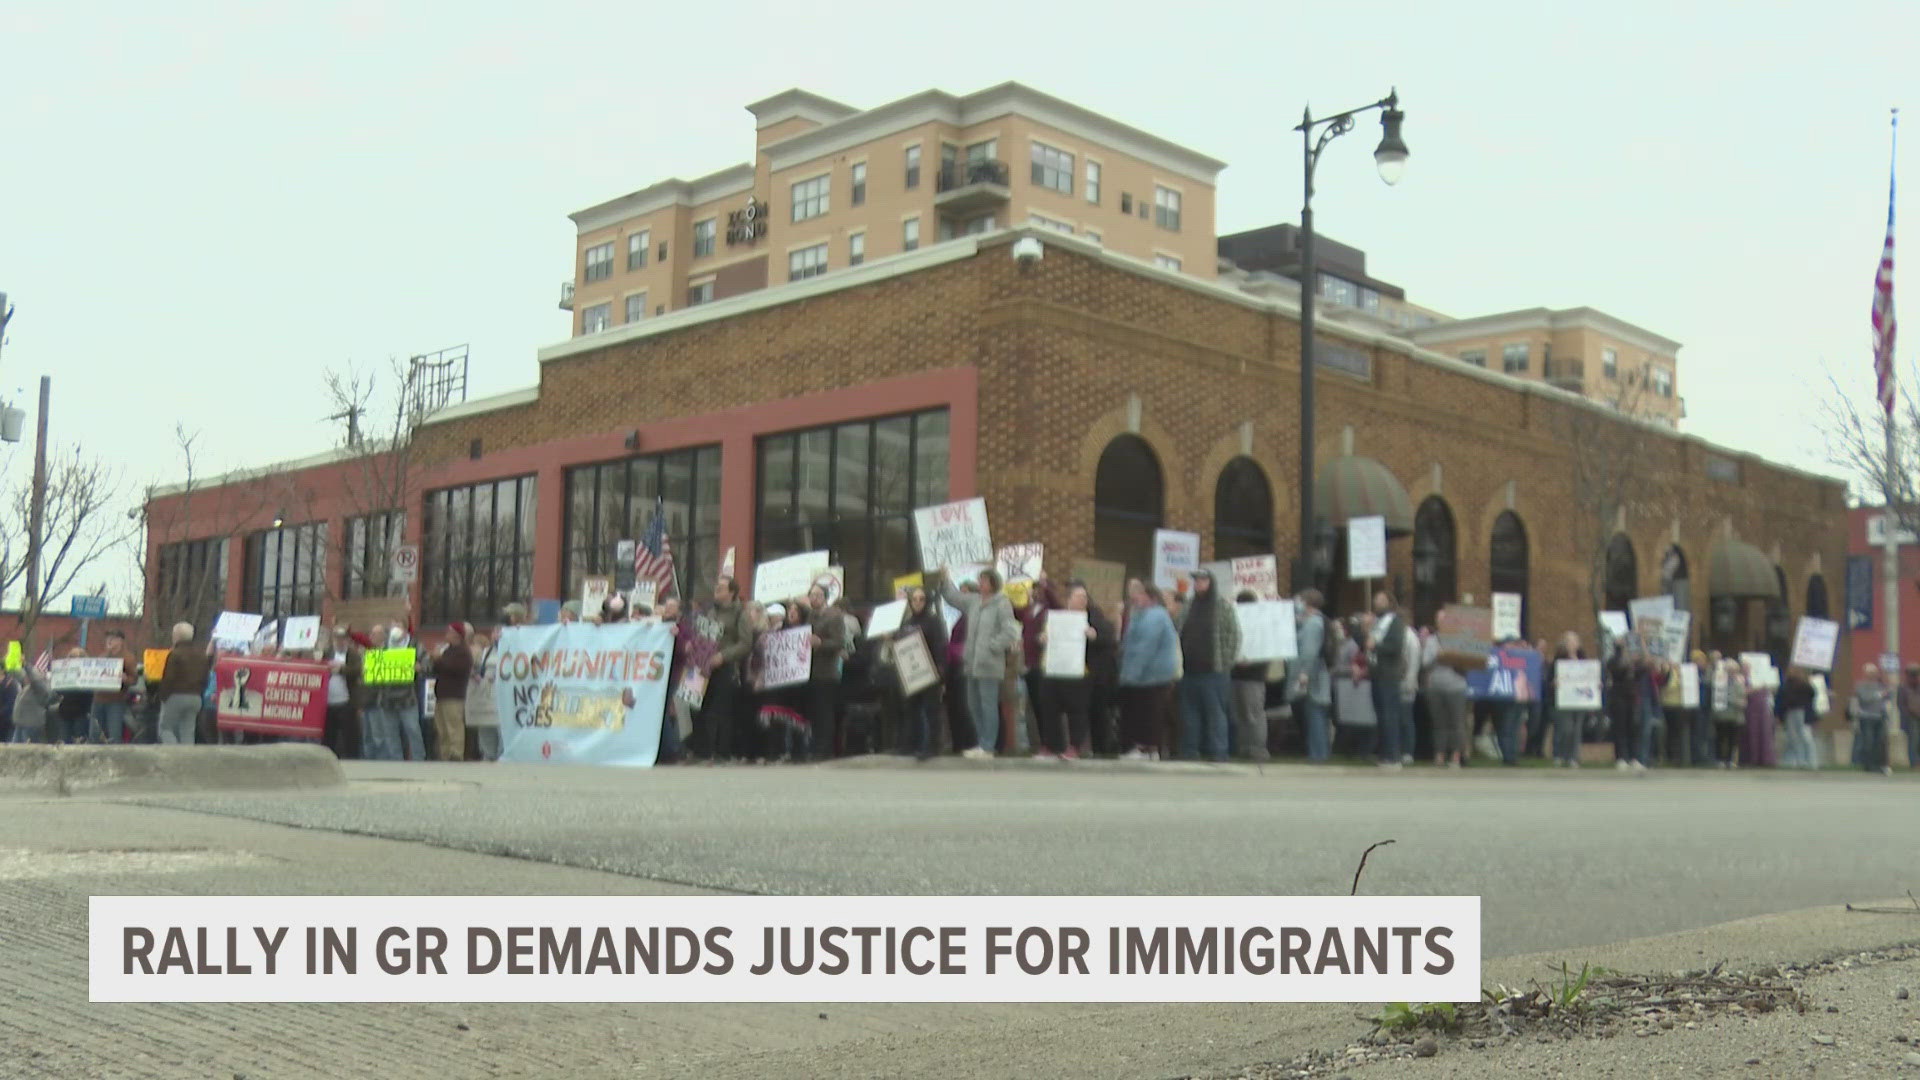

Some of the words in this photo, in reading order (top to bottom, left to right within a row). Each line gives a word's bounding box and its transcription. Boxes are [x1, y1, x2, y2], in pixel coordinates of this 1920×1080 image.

[279, 671, 323, 689] DETENTION
[265, 686, 300, 704] CENTERS
[301, 690, 311, 705] IN
[263, 703, 304, 720] MICHIGAN
